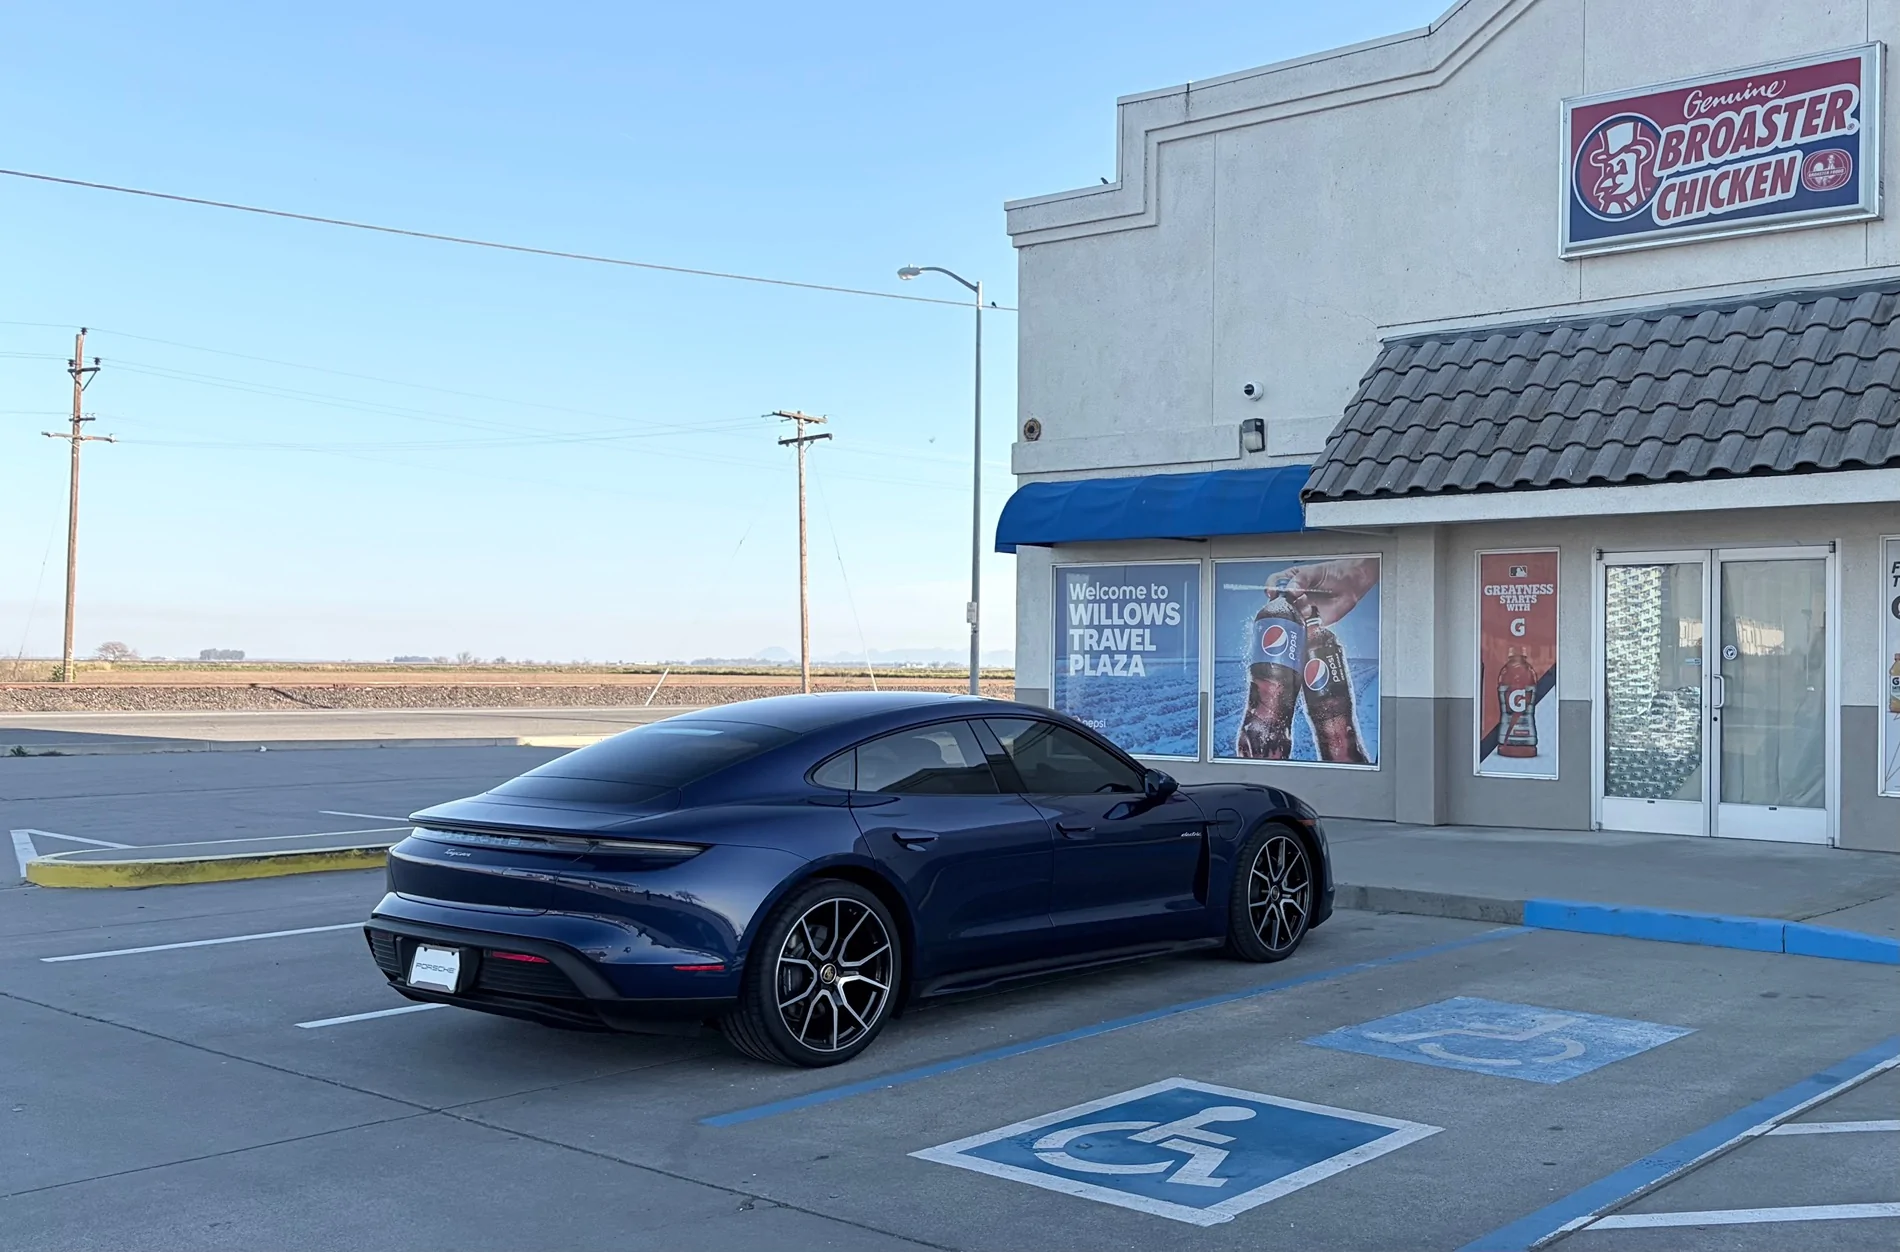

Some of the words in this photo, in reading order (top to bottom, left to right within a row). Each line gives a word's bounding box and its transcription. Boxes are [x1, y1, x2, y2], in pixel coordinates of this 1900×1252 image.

[1683, 79, 1787, 119] Genuine
[1656, 88, 1855, 173] BROASTER
[1656, 155, 1798, 220] CHICKEN
[1069, 582, 1147, 600] Welcome
[1151, 583, 1168, 599] to
[1484, 584, 1554, 595] GREATNESS
[1500, 594, 1537, 604] STARTS
[1069, 602, 1181, 626] WILLOWS
[1506, 603, 1531, 611] WITH
[1510, 618, 1525, 637] G
[1069, 628, 1156, 651] TRAVEL
[1288, 631, 1298, 661] pepsi
[1069, 654, 1145, 677] PLAZA
[1326, 654, 1341, 683] pepsi
[1509, 689, 1526, 713] G
[416, 962, 456, 974] PORSCHE
